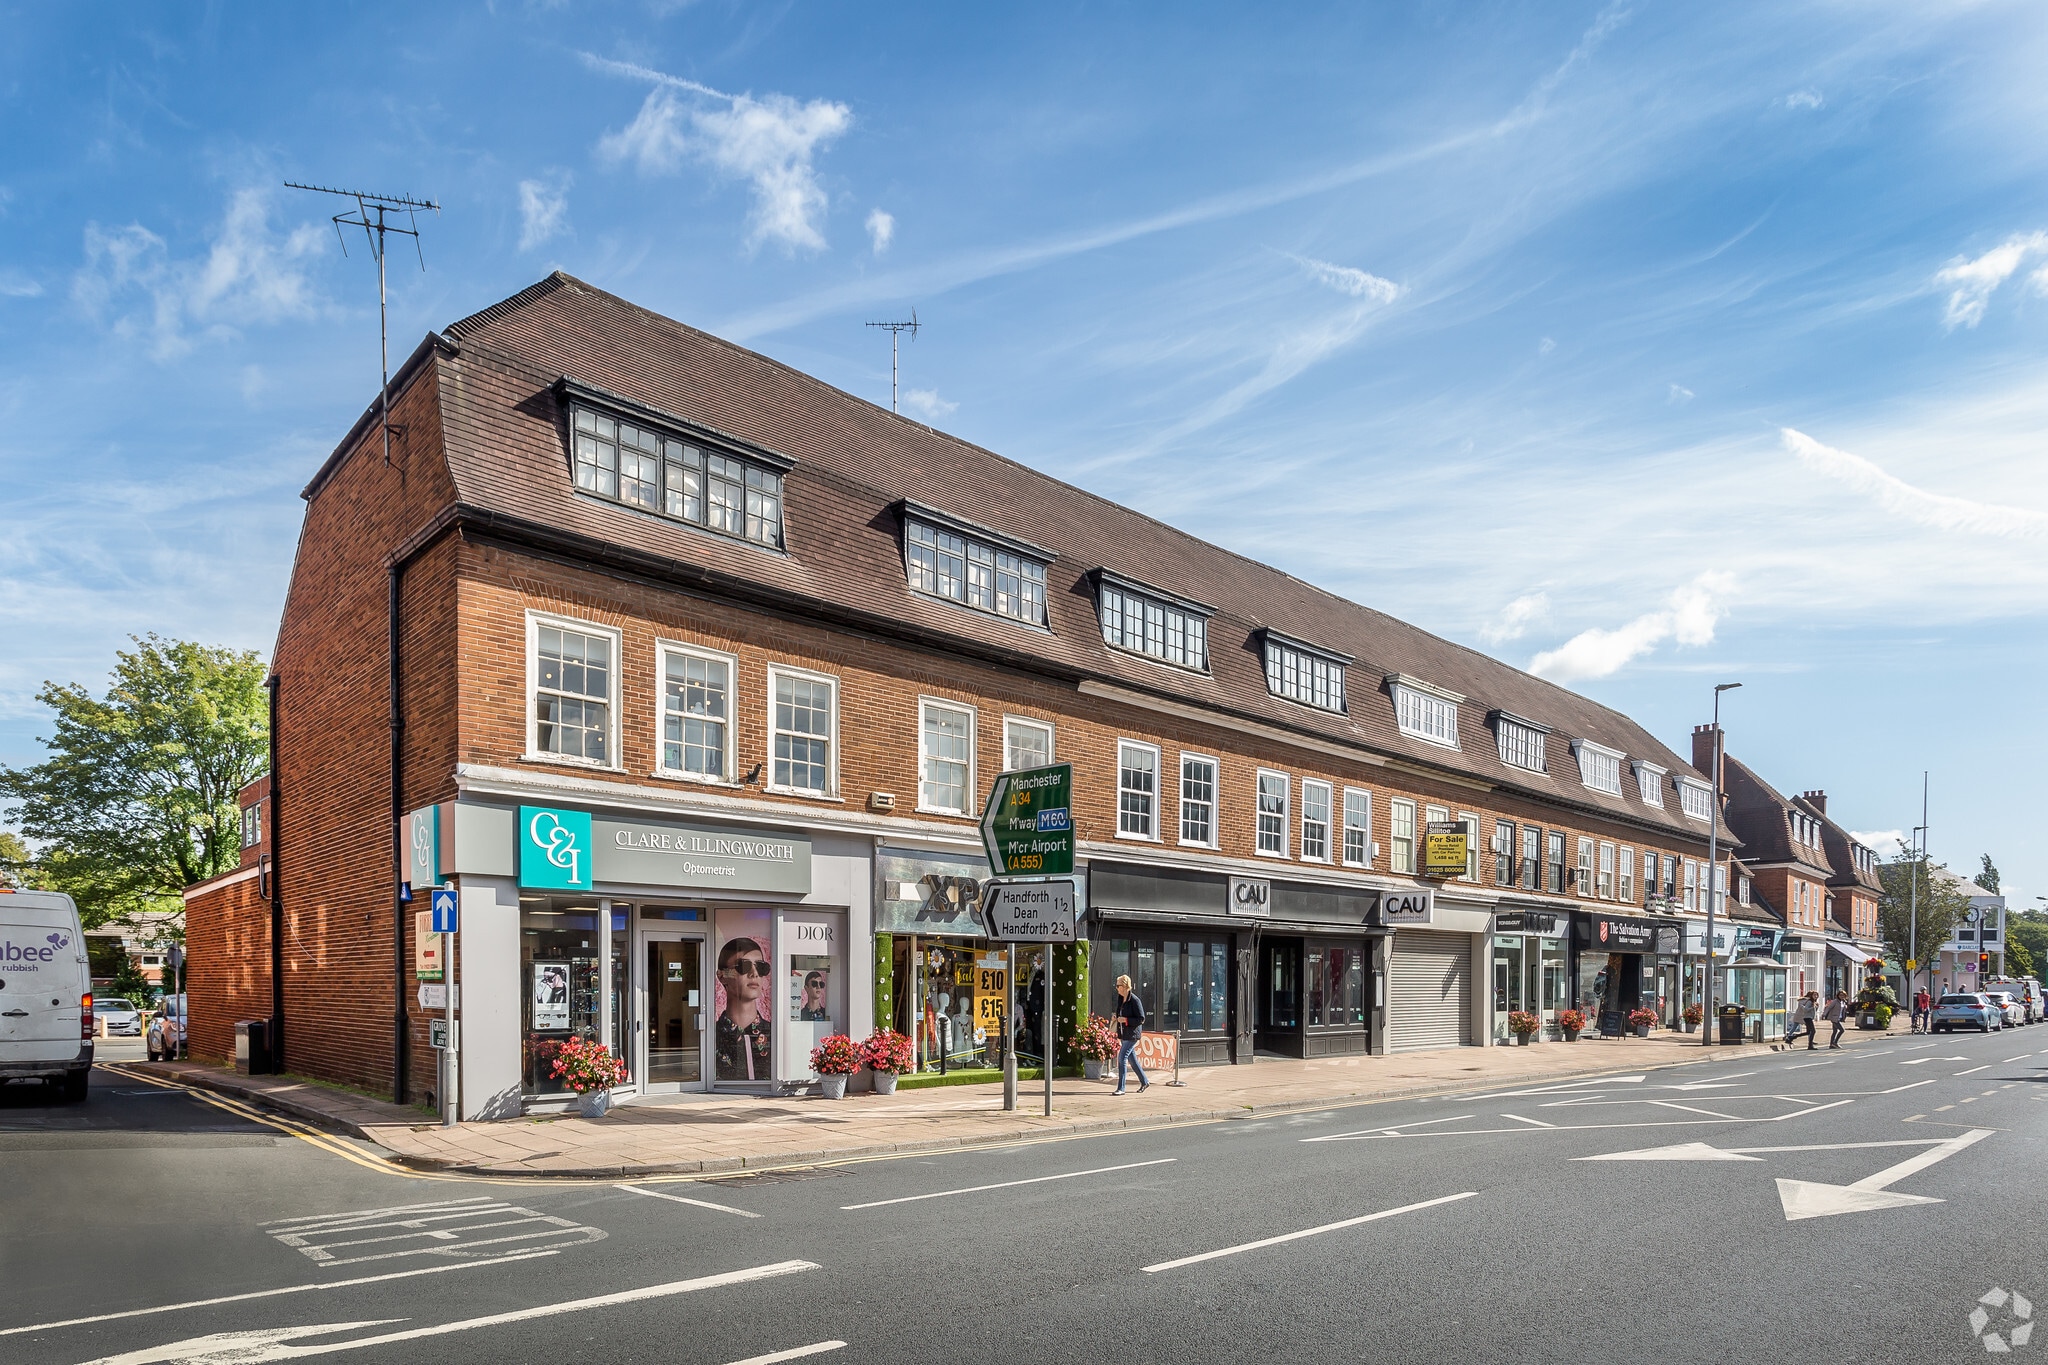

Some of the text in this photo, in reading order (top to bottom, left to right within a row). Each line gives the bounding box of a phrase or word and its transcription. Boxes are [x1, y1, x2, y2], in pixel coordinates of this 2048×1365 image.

[1011, 773, 1061, 791] Manchester
[1010, 817, 1036, 831] M'way
[615, 830, 794, 859] CLARE & ILLINGWORTH
[1009, 838, 1067, 854] M'cr Airport
[683, 861, 736, 877] Optometrist
[1003, 890, 1049, 903] Handforth
[1236, 883, 1267, 905] CAU
[1014, 907, 1038, 919] Dean
[1386, 896, 1426, 913] CAU
[798, 926, 834, 941] DIOR
[1002, 922, 1048, 935] Handforth
[1609, 922, 1652, 940] The Salvation Army
[0, 941, 53, 962] bee
[981, 970, 1004, 990] £10
[981, 998, 1003, 1018] £15
